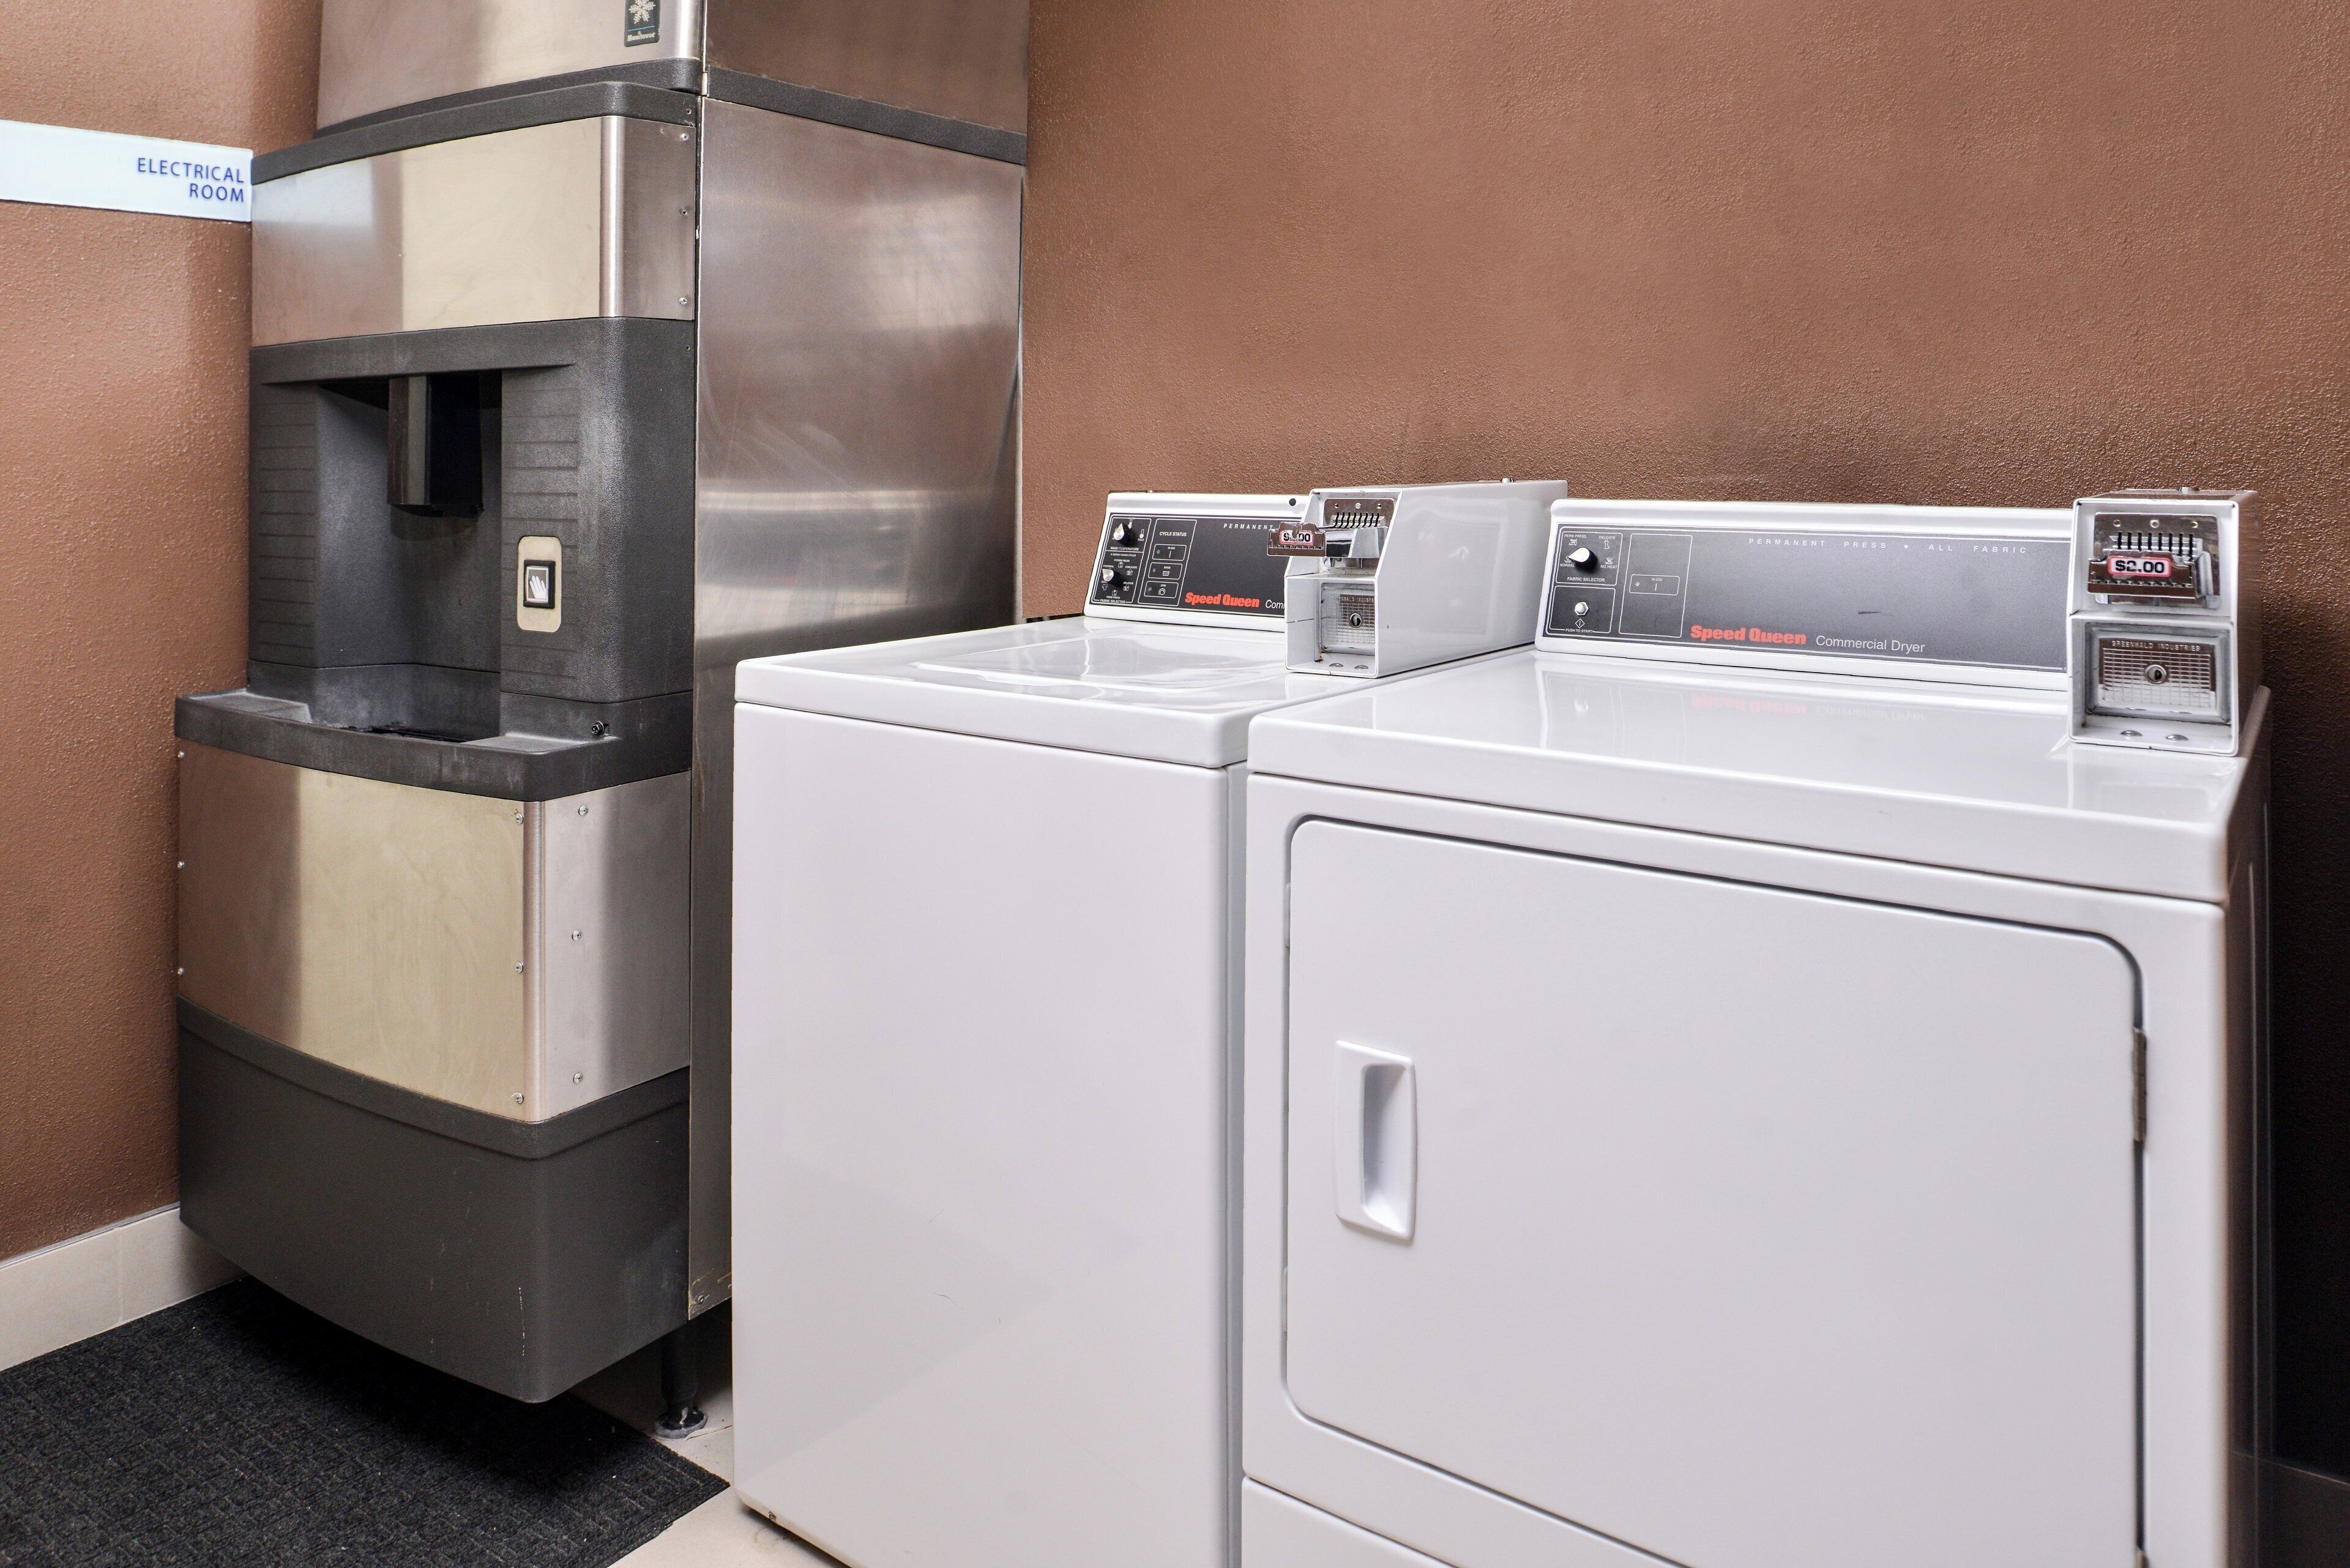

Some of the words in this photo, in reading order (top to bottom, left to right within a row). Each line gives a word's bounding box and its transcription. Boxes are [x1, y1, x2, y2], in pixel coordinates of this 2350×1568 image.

[138, 157, 244, 183] ELECTRICAL
[190, 183, 244, 202] ROOM
[1748, 538, 1826, 547] PERMANENT
[2115, 559, 2165, 573] $2.00
[1185, 592, 1222, 605] Speed
[1222, 594, 1260, 608] Queen
[1690, 625, 1746, 642] Speed
[1748, 627, 1807, 645] Queen
[1816, 635, 1887, 650] Commercial
[1891, 640, 1926, 655] Dryer
[2158, 643, 2201, 652] INDUSTRIES
